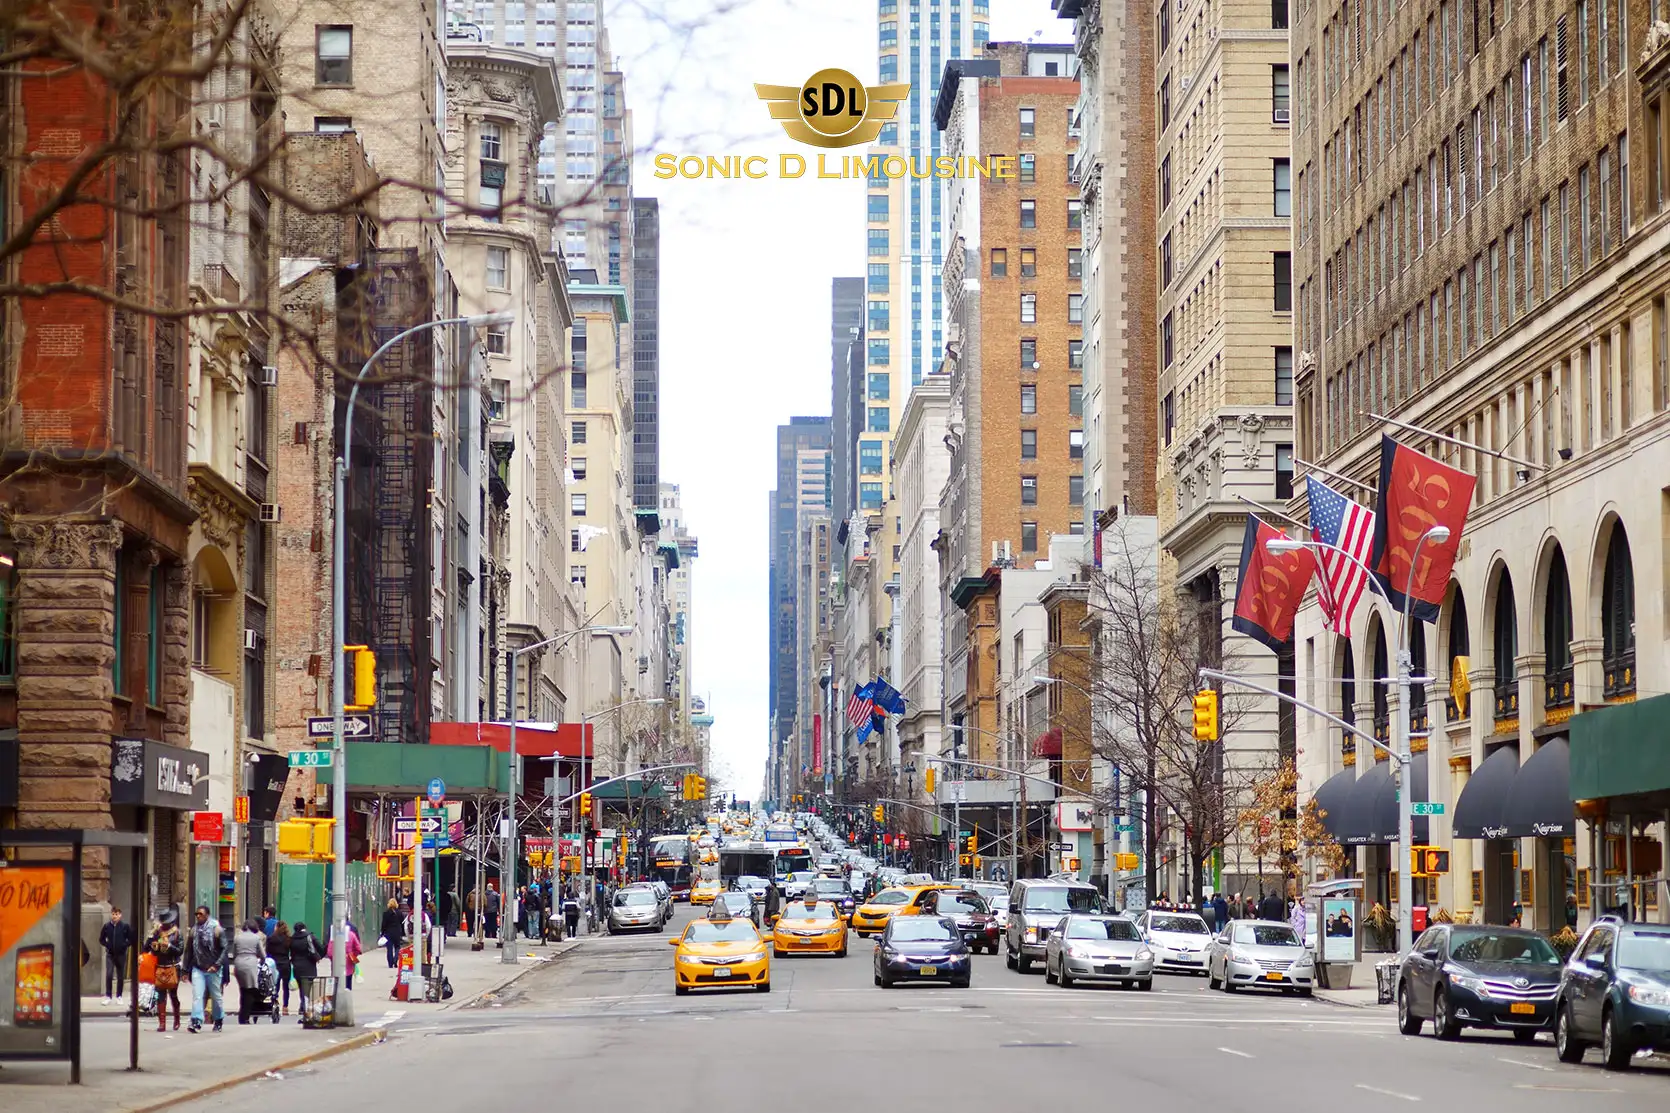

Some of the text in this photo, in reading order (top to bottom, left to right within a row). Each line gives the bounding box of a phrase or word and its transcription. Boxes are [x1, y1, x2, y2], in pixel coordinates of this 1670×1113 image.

[316, 721, 361, 732] ONE WAY
[291, 752, 300, 765] W
[304, 752, 318, 765] 30
[1414, 804, 1420, 814] E
[1422, 804, 1434, 814] 30
[18, 880, 50, 911] DATA
